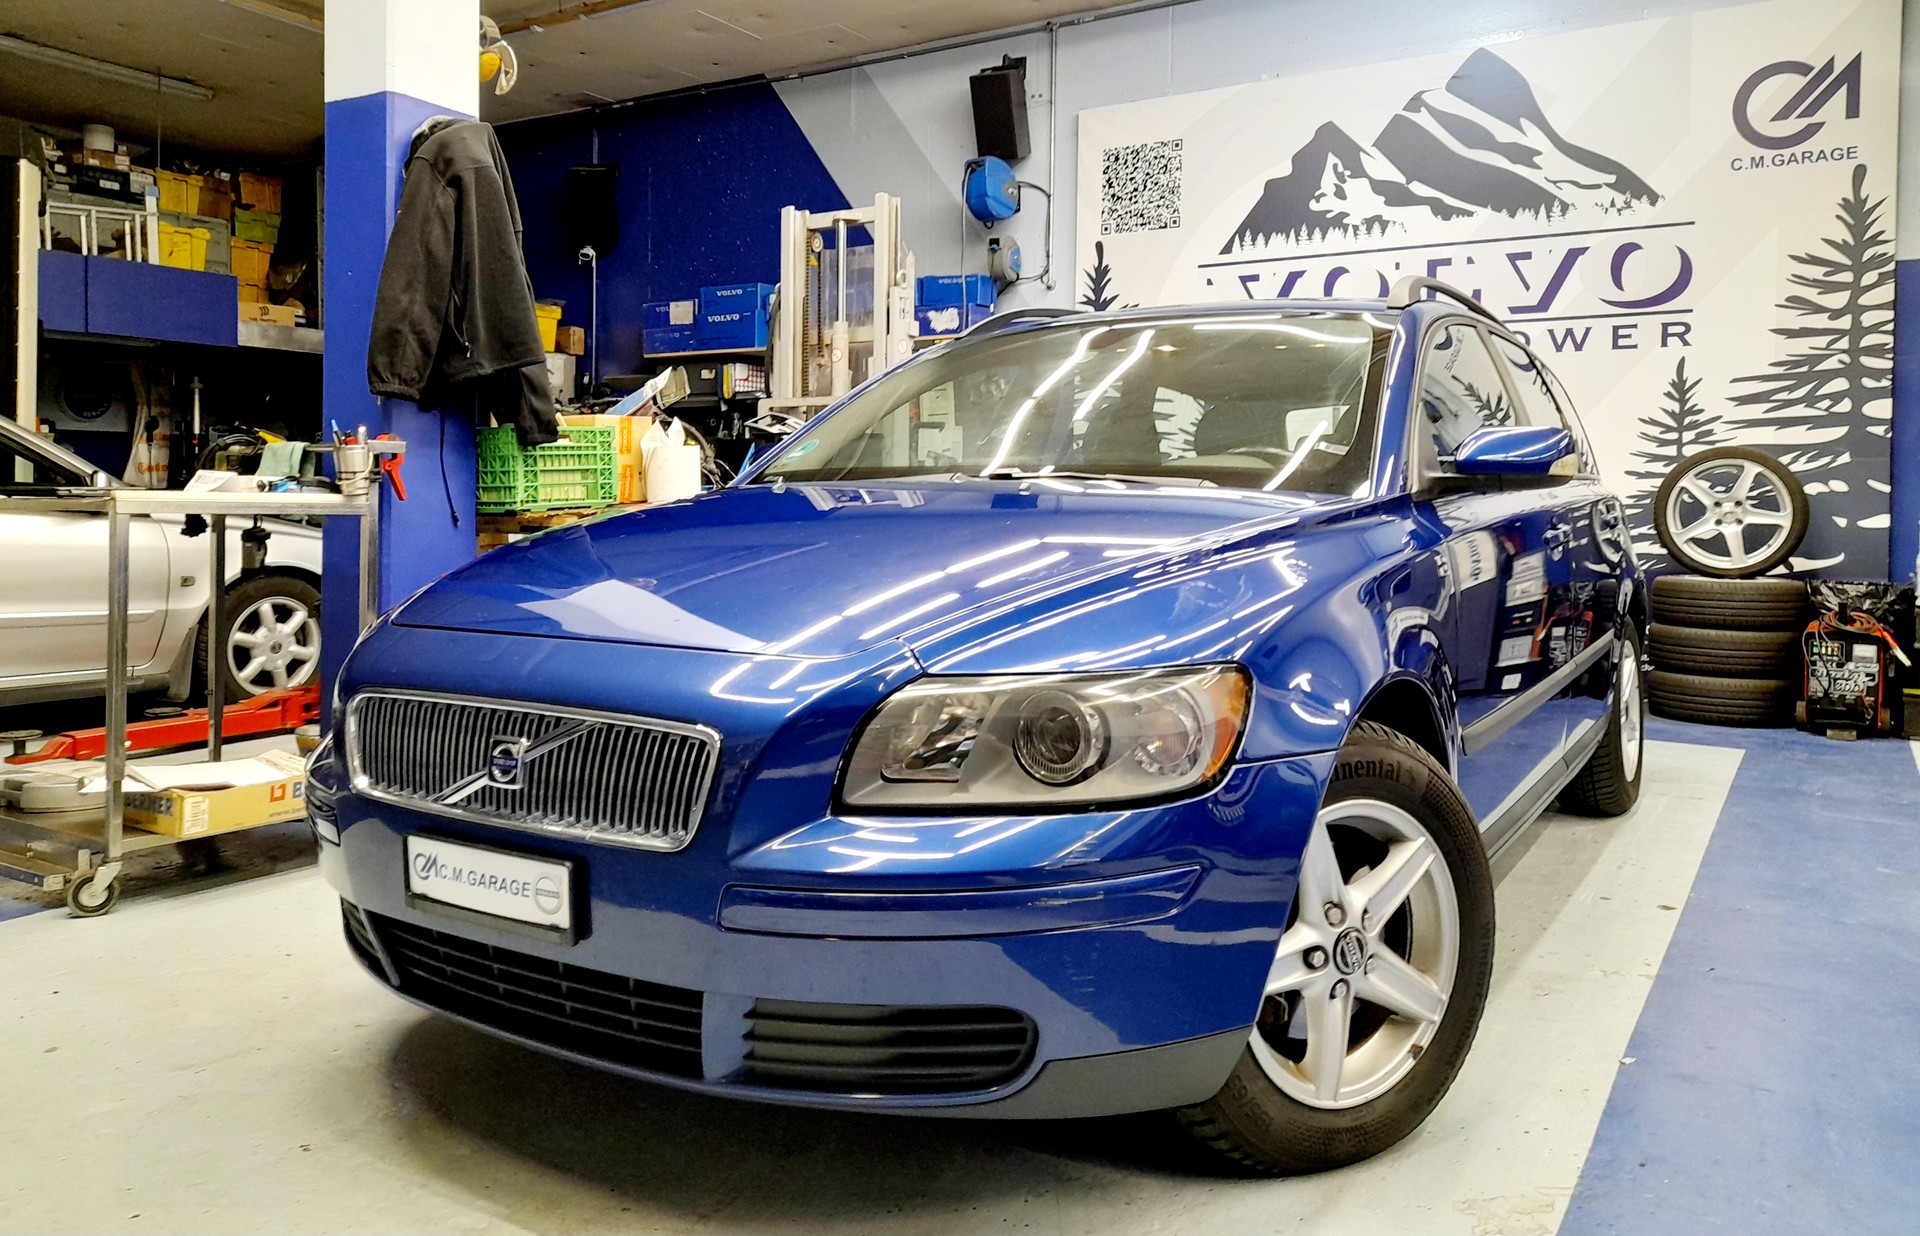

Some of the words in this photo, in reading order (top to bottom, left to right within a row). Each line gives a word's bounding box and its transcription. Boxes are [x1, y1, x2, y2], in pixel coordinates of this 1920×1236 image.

[1731, 146, 1859, 171] C.M.GARAGE
[716, 289, 743, 297] VOLVO
[655, 305, 669, 313] VOL
[707, 313, 740, 323] VOLVO
[439, 863, 531, 898] C.M.GARAGE
